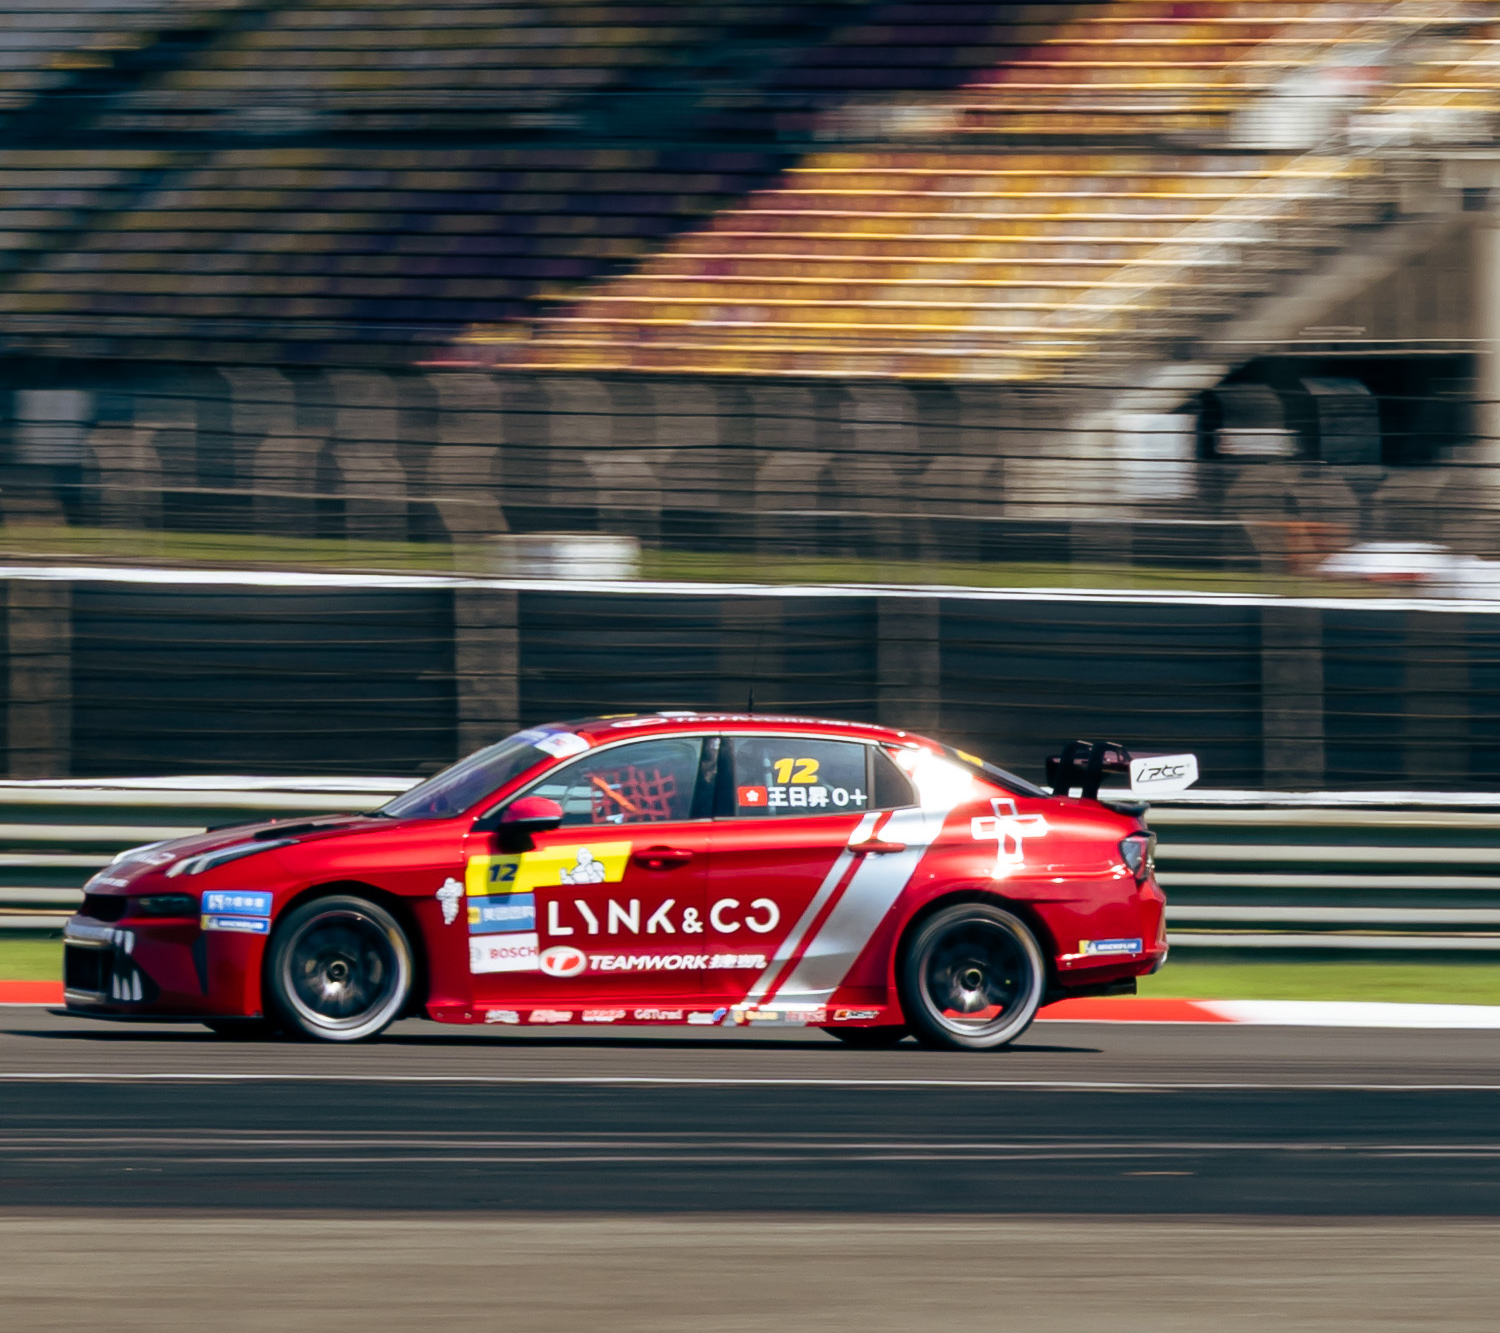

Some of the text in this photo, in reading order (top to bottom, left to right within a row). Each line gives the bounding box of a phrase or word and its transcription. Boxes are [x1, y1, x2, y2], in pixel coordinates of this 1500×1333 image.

[774, 758, 820, 784] 12
[488, 863, 518, 882] 12
[489, 946, 539, 959] BOSCH
[589, 954, 709, 971] TEAMWORK
